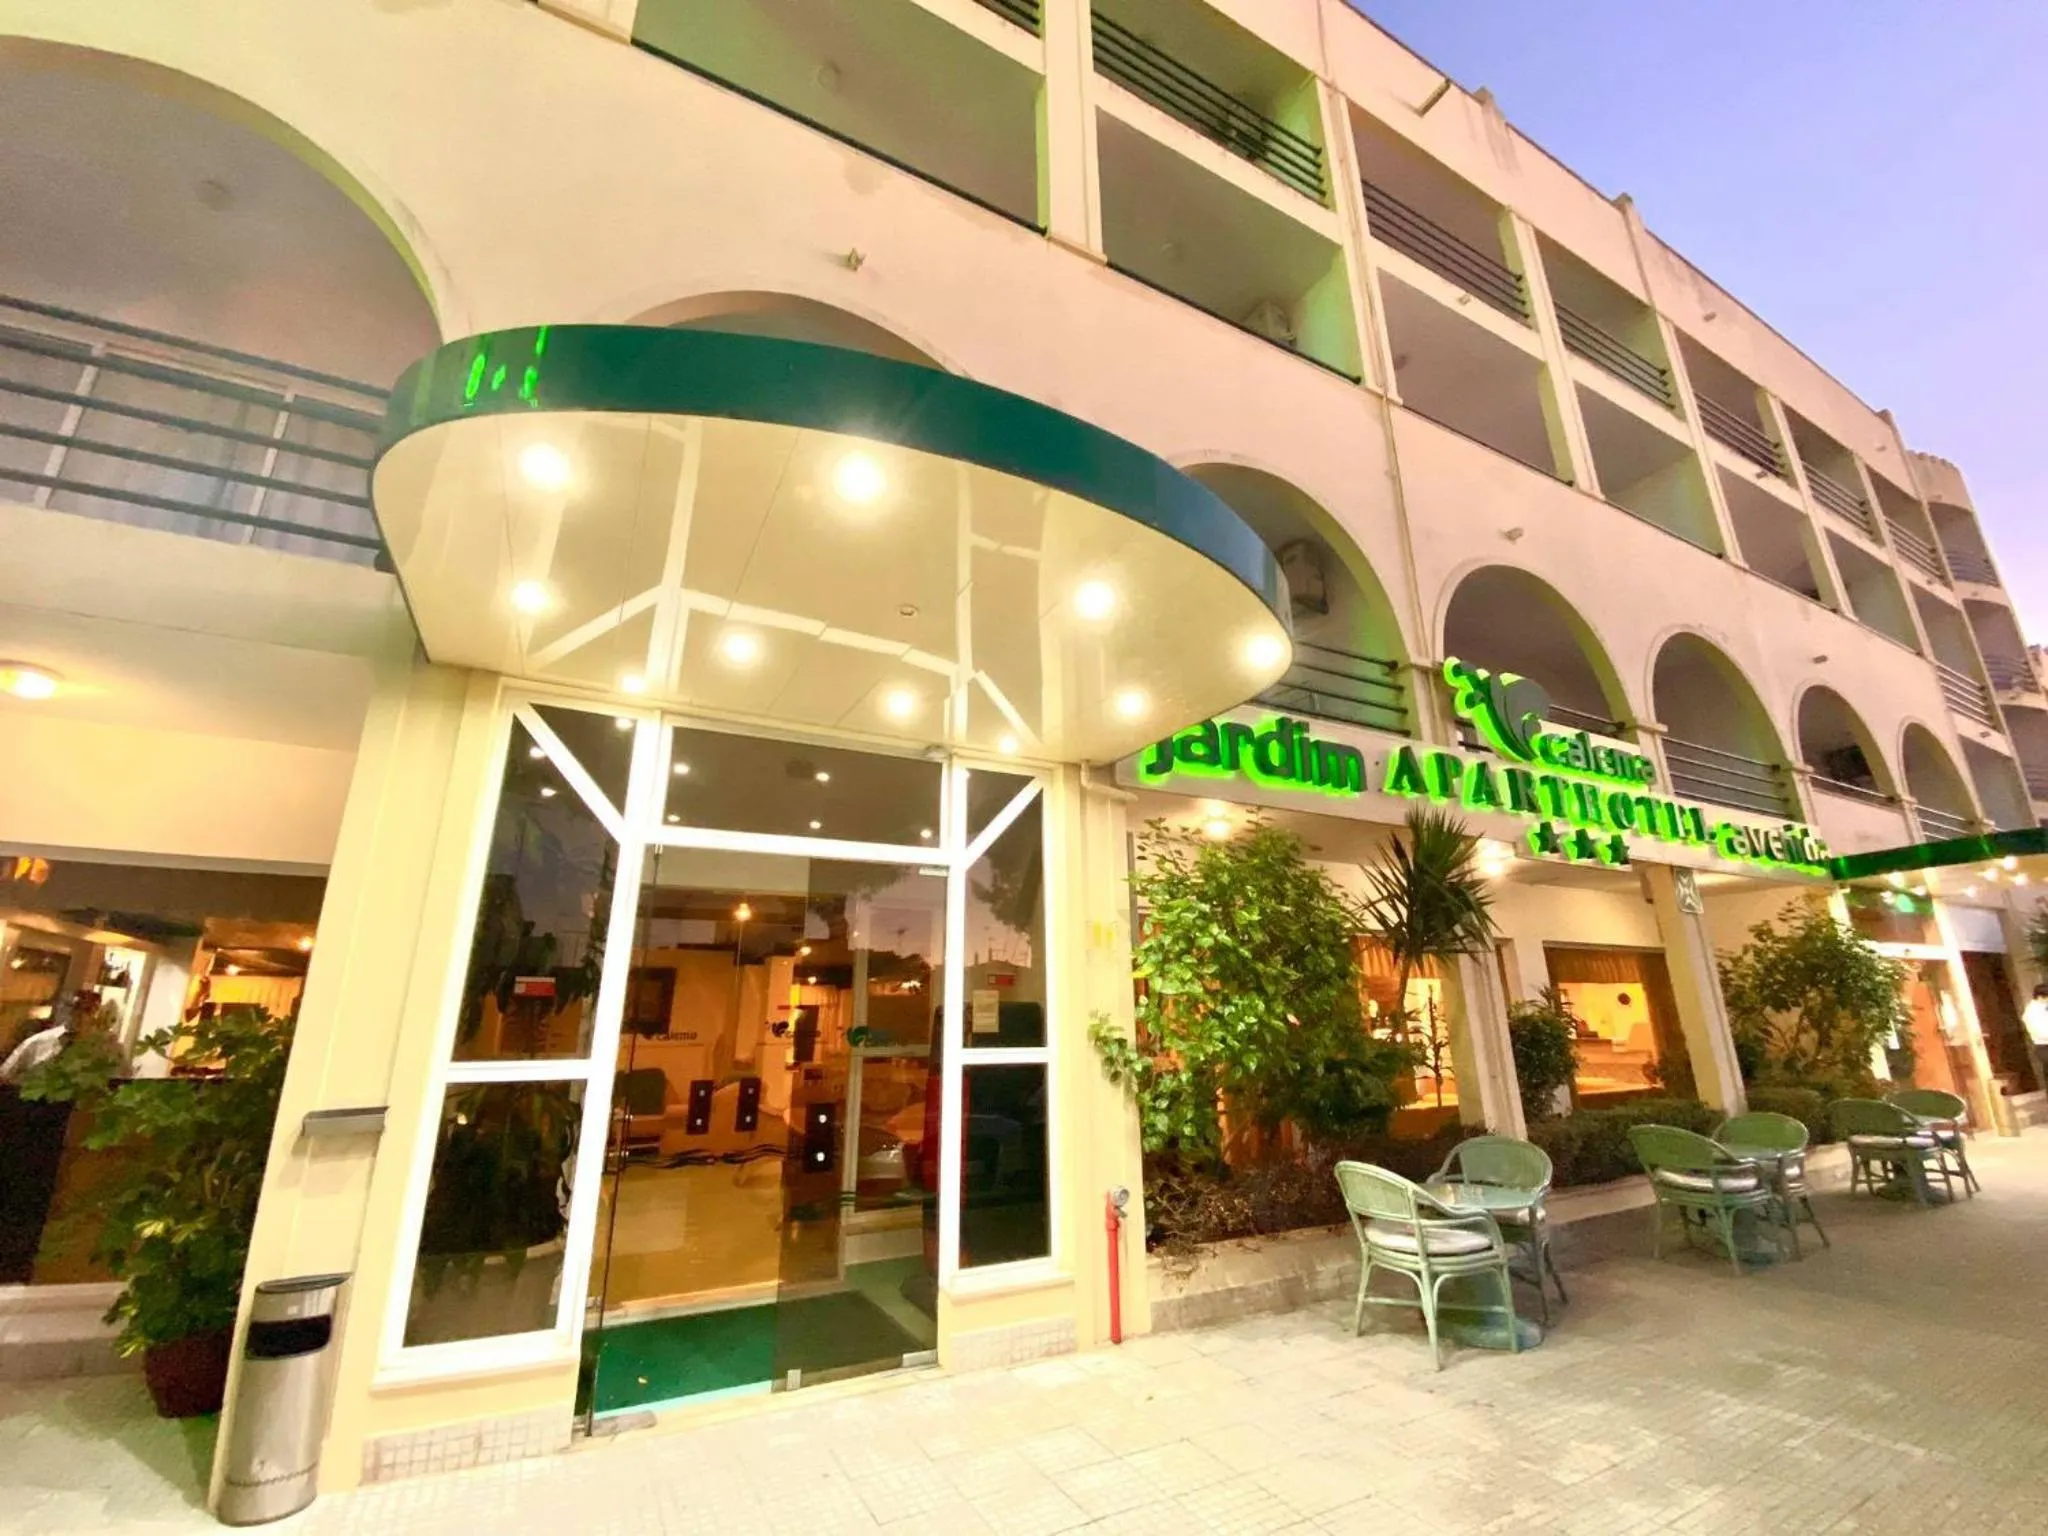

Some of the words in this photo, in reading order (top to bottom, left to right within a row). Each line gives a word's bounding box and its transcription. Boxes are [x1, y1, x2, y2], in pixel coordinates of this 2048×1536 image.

[1145, 716, 1368, 793] jardim
[1388, 745, 1716, 842] APARTHOTEL
[1538, 731, 1656, 786] calema
